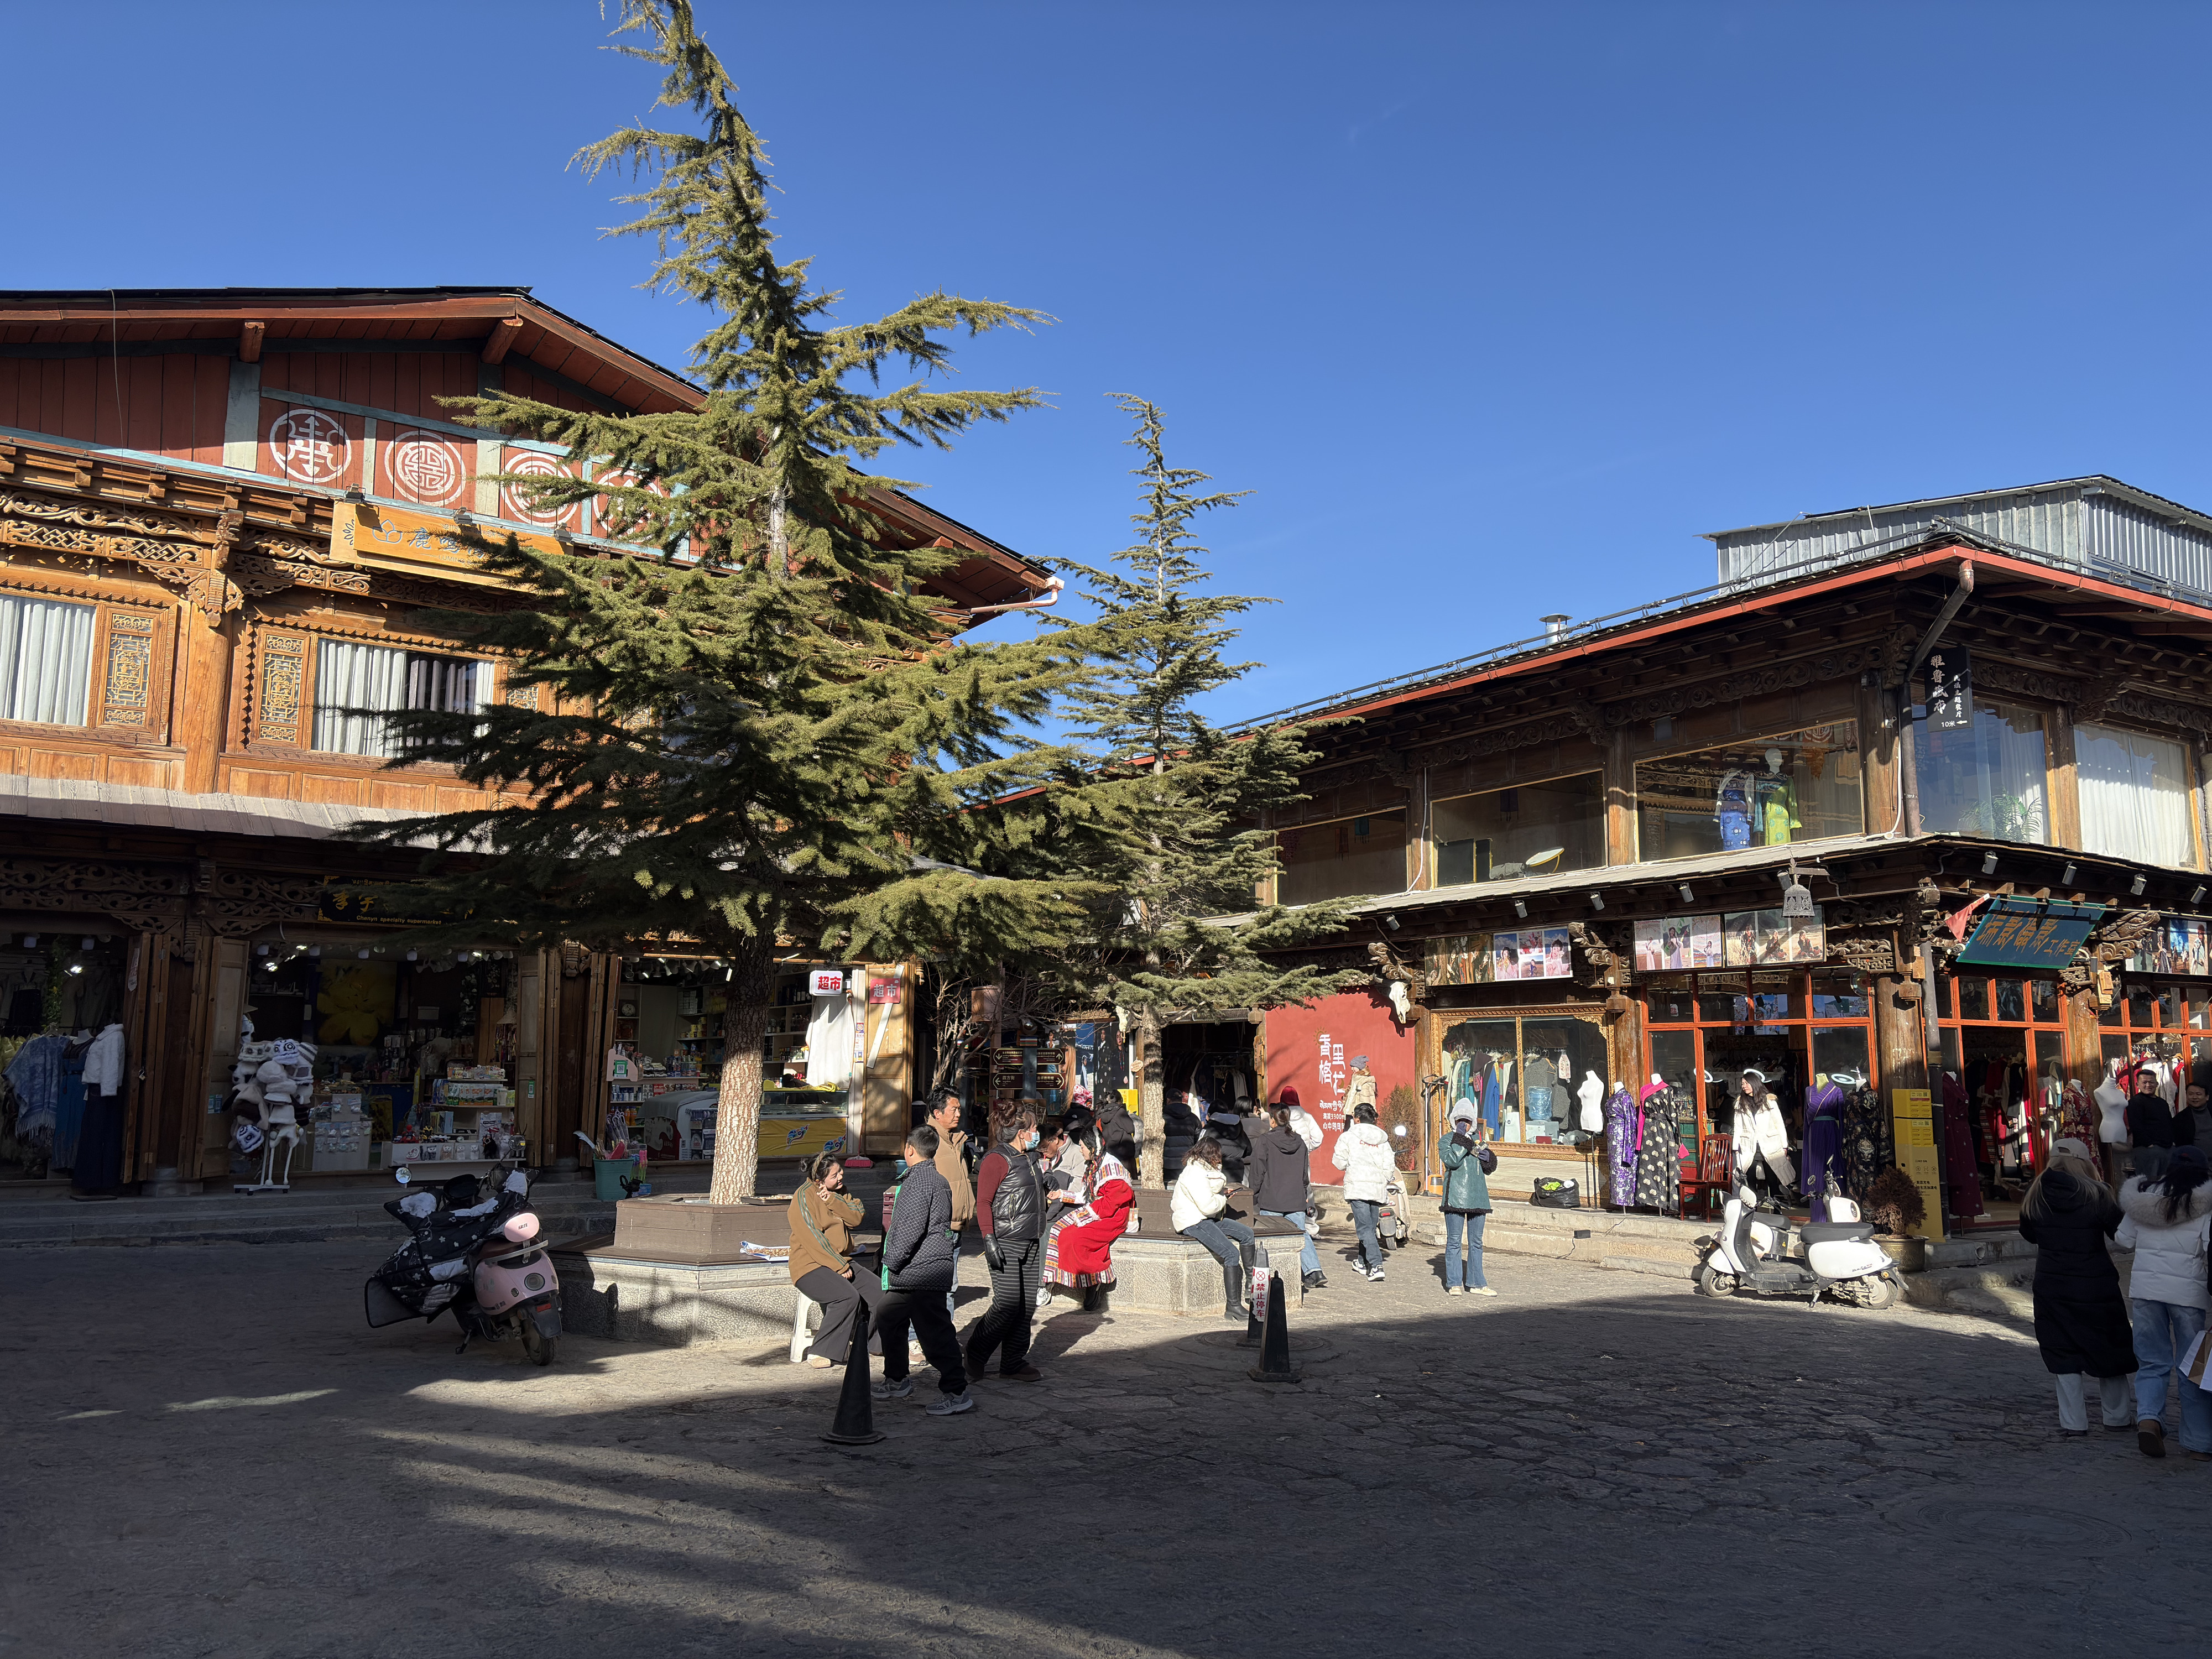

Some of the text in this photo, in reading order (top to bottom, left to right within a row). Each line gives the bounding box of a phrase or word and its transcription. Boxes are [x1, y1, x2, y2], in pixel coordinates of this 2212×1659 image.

[818, 976, 841, 991] 超市
[874, 984, 897, 998] 超市
[1256, 1283, 1265, 1318] 禁止停车
